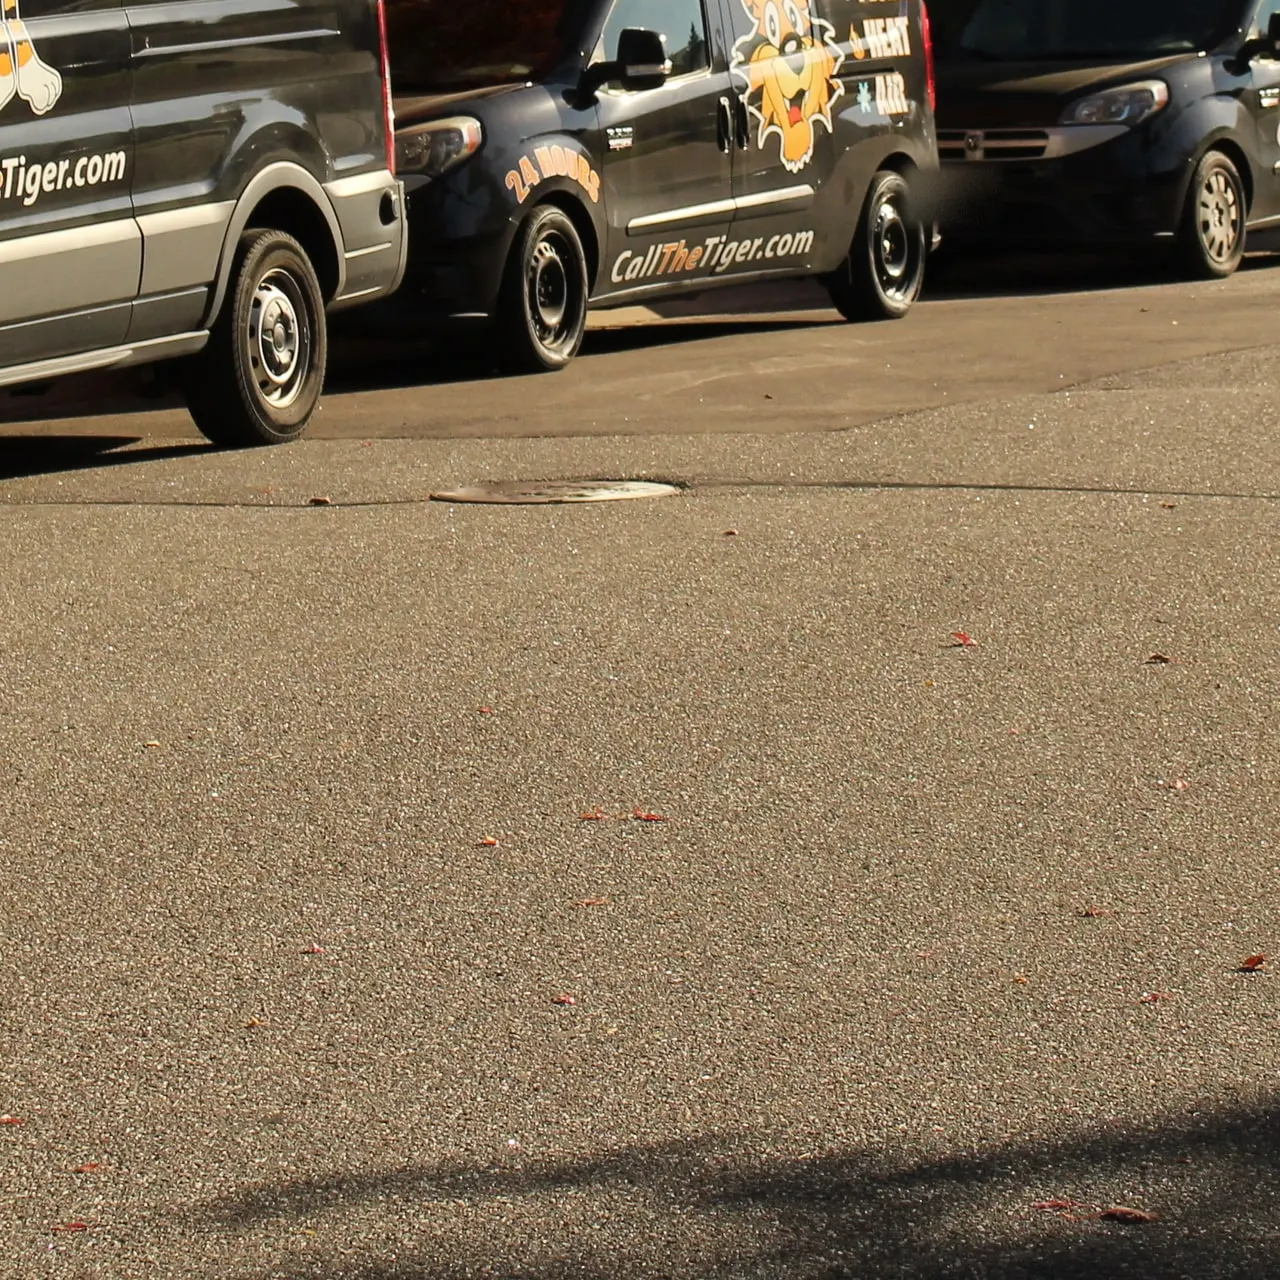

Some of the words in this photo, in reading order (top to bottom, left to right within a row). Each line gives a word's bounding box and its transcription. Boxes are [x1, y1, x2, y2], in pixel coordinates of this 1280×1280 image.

[862, 16, 912, 58] HEAT
[875, 72, 909, 115] AIR
[505, 155, 541, 204] 24
[534, 144, 600, 203] HOURS
[611, 230, 815, 283] CallTheTiger.com
